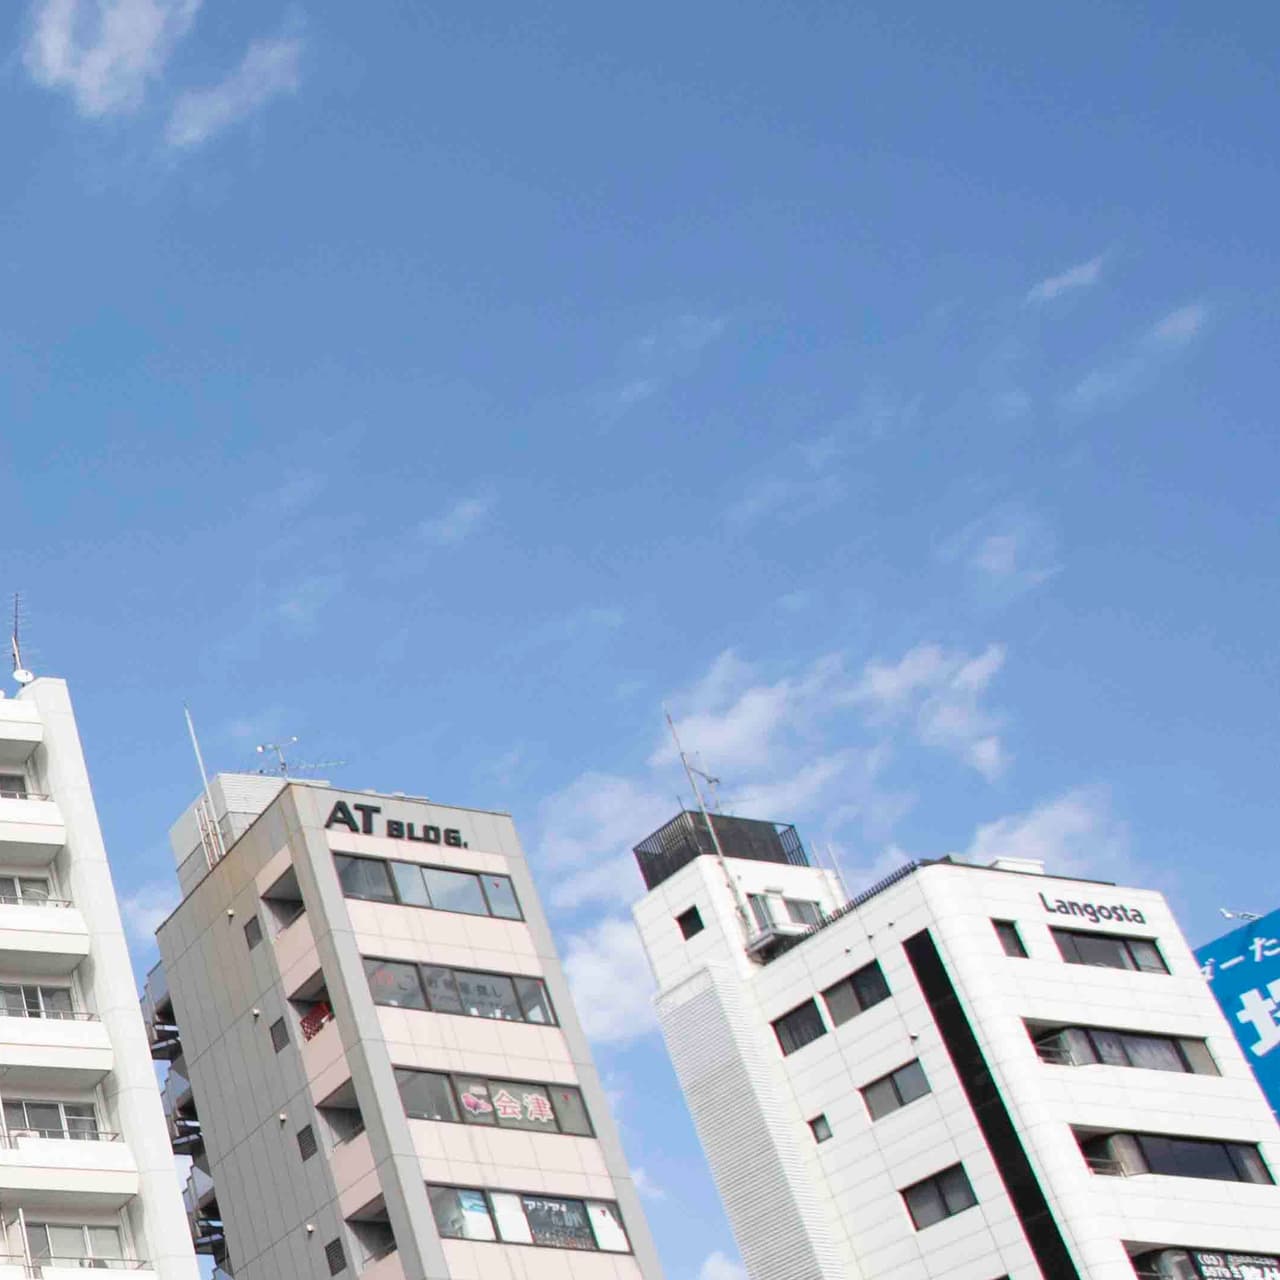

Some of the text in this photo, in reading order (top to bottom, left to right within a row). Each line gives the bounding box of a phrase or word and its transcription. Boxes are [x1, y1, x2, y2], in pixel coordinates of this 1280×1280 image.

[325, 801, 381, 834] AT
[1039, 892, 1148, 927] Langosta
[493, 1089, 554, 1122] 会津
